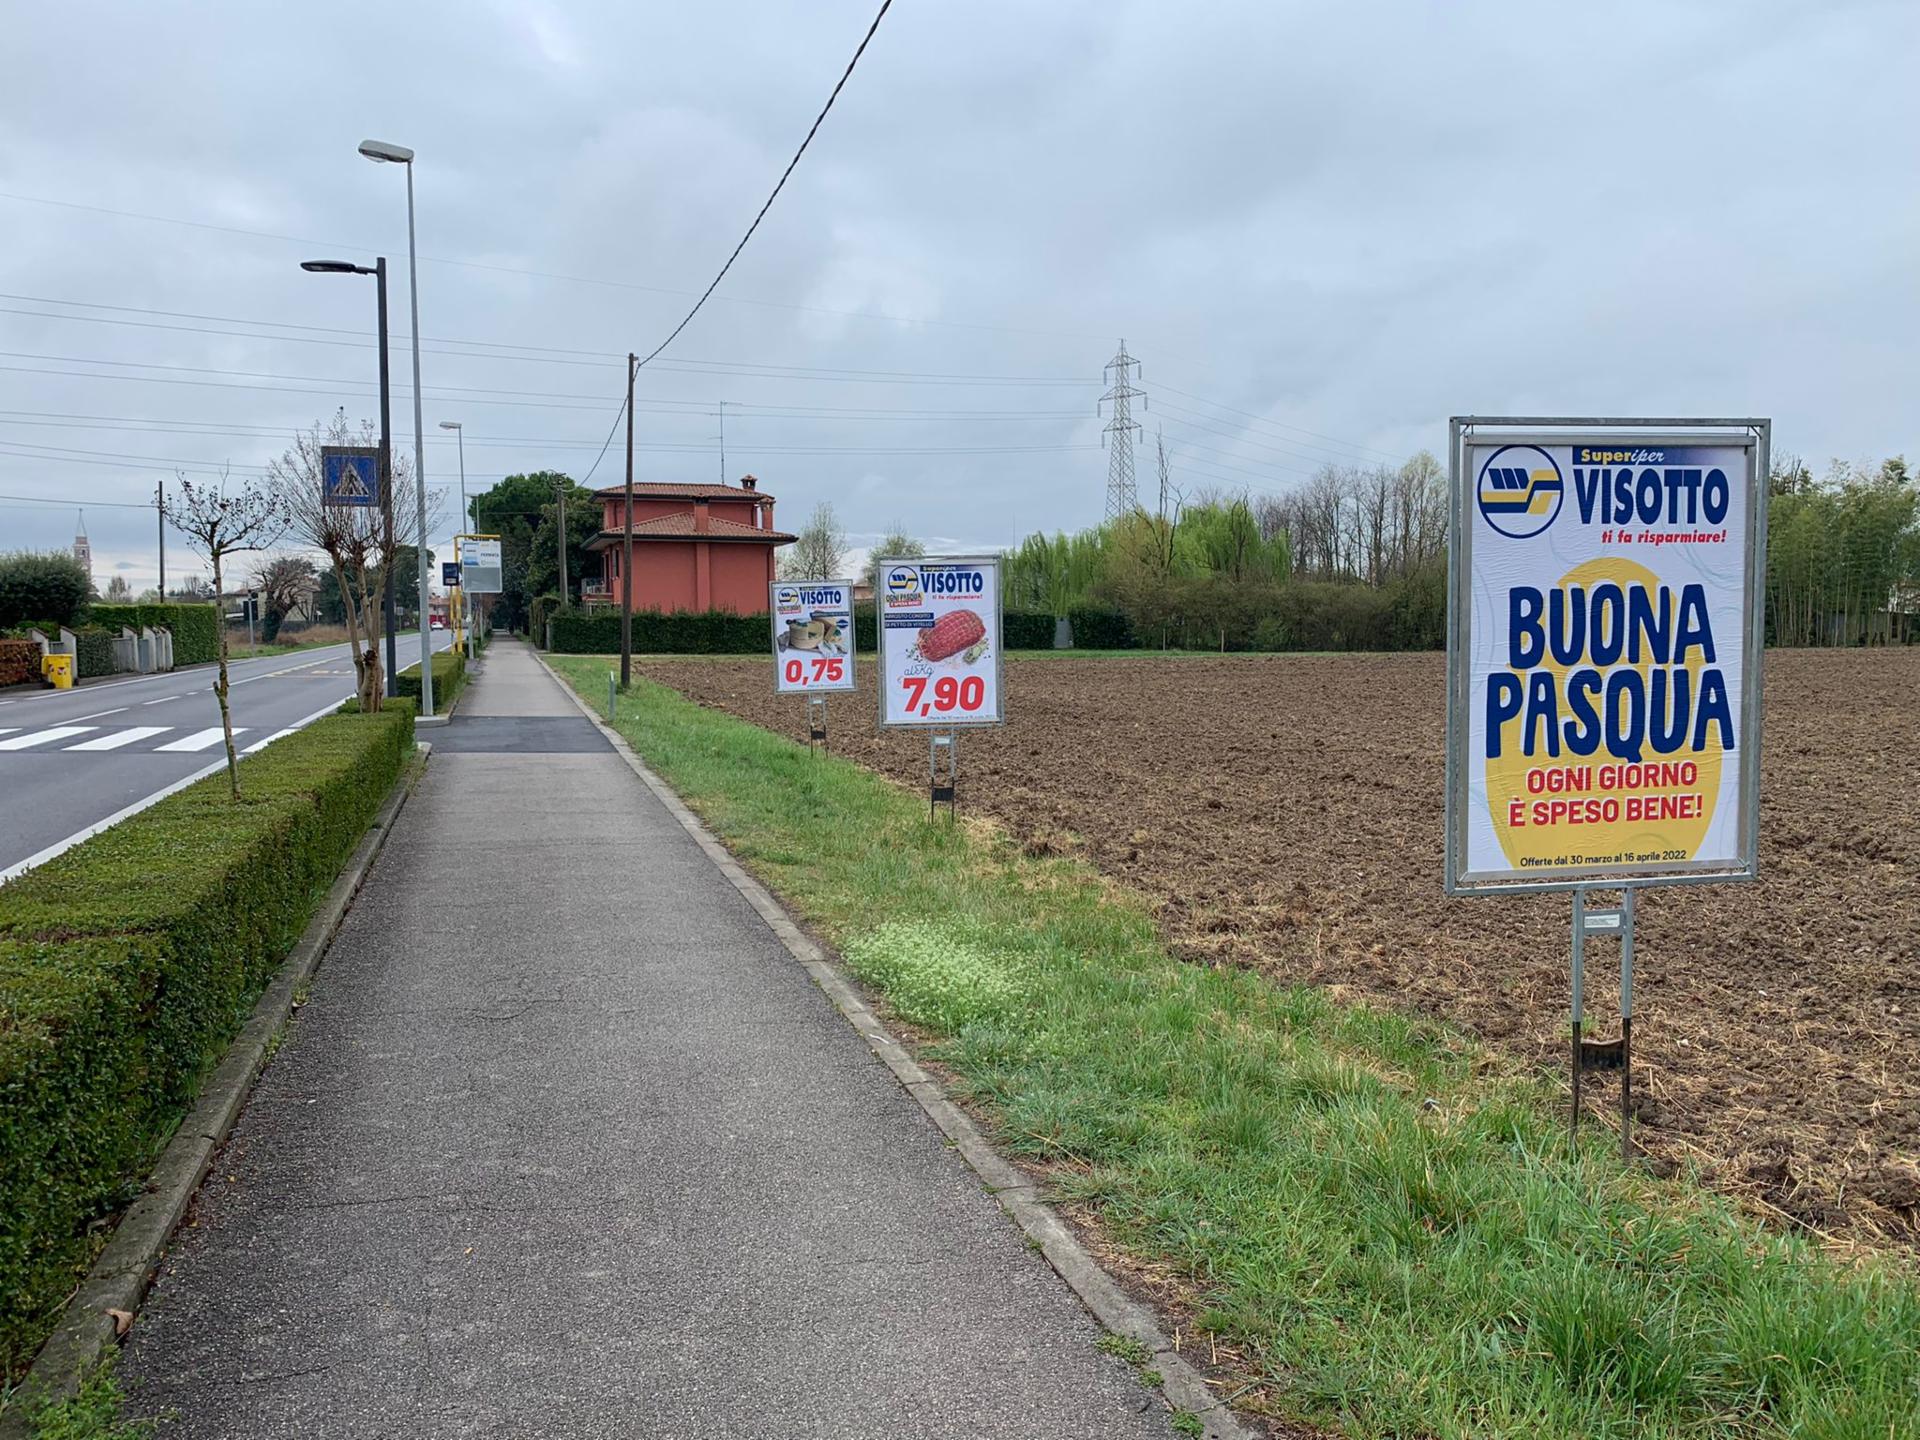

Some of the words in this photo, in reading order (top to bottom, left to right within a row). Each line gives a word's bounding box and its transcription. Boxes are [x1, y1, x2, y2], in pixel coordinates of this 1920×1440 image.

[1580, 448, 1665, 466] Superiper
[1573, 468, 1729, 525] VISOTTO
[1601, 529, 1613, 543] ti
[1618, 529, 1632, 543] fa
[1637, 529, 1727, 546] risparmiare!
[800, 590, 842, 604] VISOTTO
[920, 572, 983, 593] VISOTTO
[1509, 584, 1717, 669] BUONA
[785, 658, 843, 685] 0,75
[903, 676, 984, 717] 7,90
[1486, 668, 1735, 764] PASQUA
[1527, 766, 1591, 794] OGNI
[1599, 761, 1698, 791] GIORNO
[1510, 797, 1526, 827] È
[1532, 798, 1619, 827] SPESO
[1626, 794, 1703, 822] BENE!
[1520, 856, 1552, 867] Offerte
[1554, 855, 1568, 866] dal
[1570, 854, 1583, 865] 30
[1585, 855, 1612, 864] marzo
[1614, 852, 1622, 862] al
[1624, 852, 1634, 862] 16
[1637, 851, 1660, 863] aprile
[1662, 849, 1687, 861] 2022
